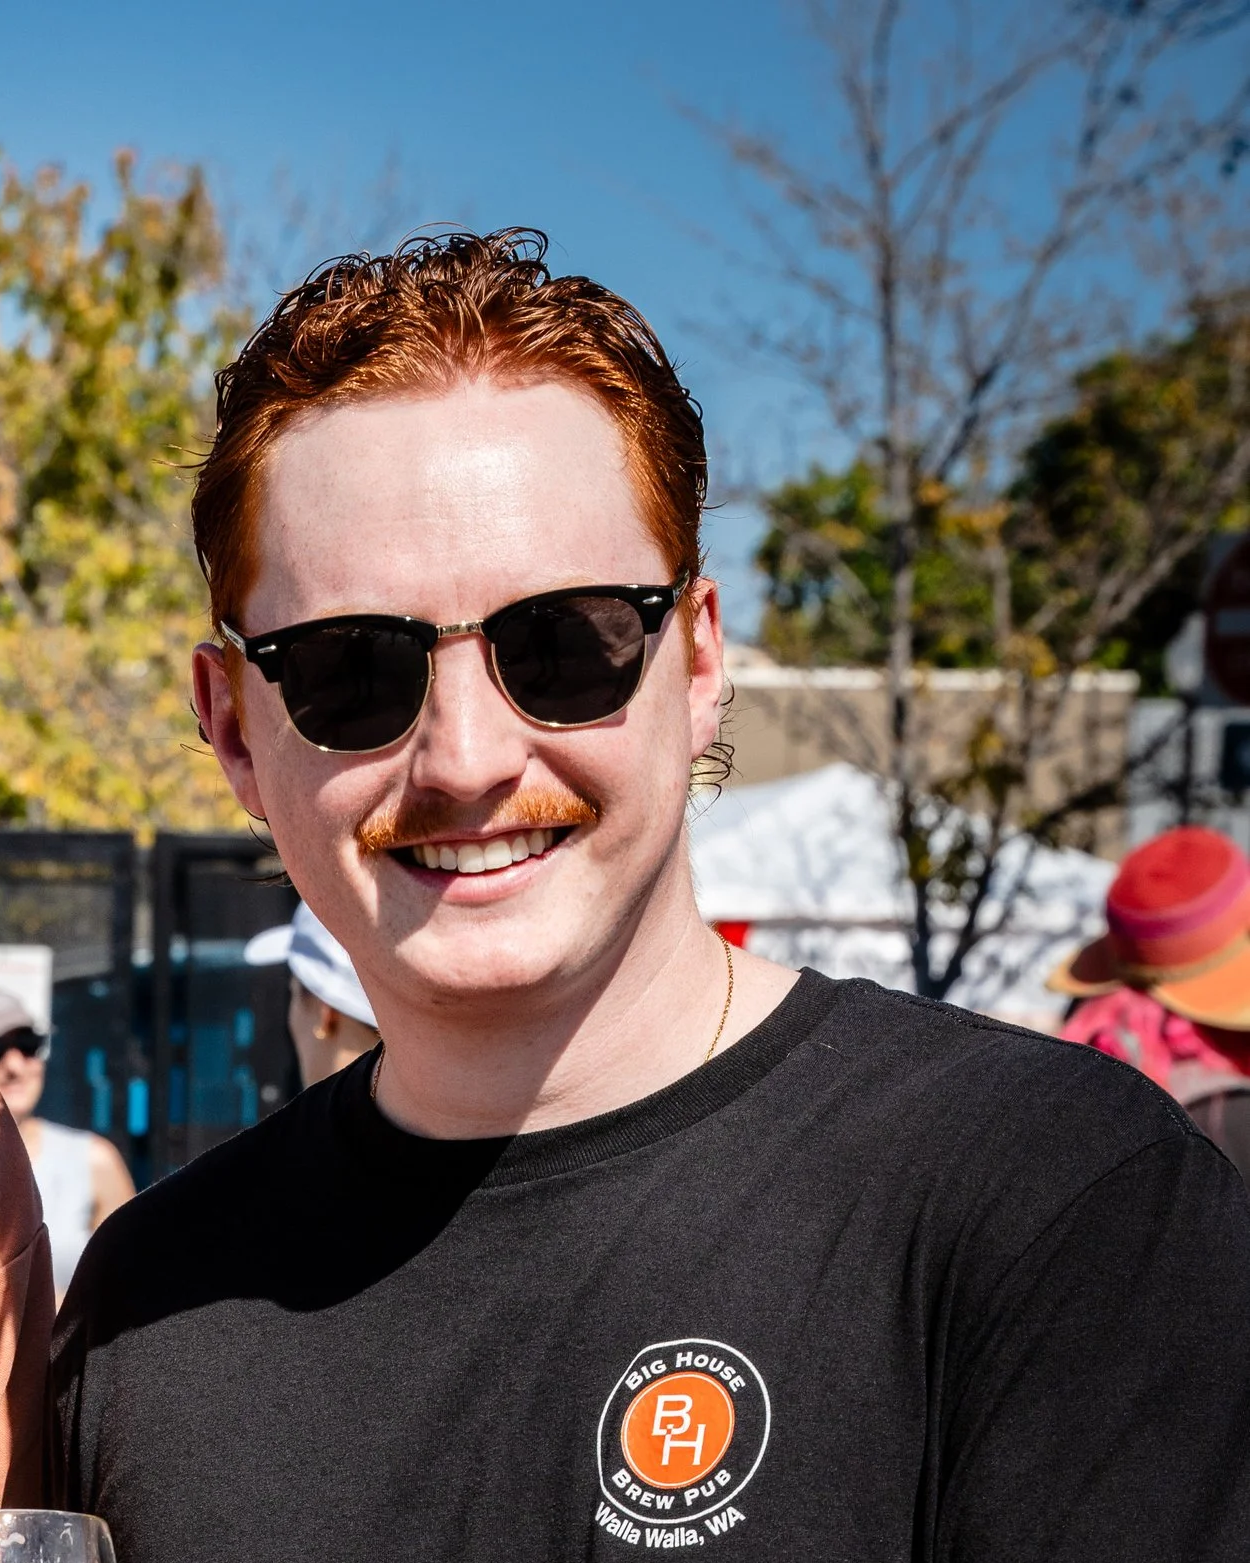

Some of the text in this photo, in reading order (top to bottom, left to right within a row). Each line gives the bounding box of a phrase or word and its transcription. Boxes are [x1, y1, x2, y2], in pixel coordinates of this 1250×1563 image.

[625, 1352, 746, 1392] BIG HOUSE
[611, 1468, 732, 1510] BREW PUB
[594, 1502, 746, 1549] Walla Walla, WA
